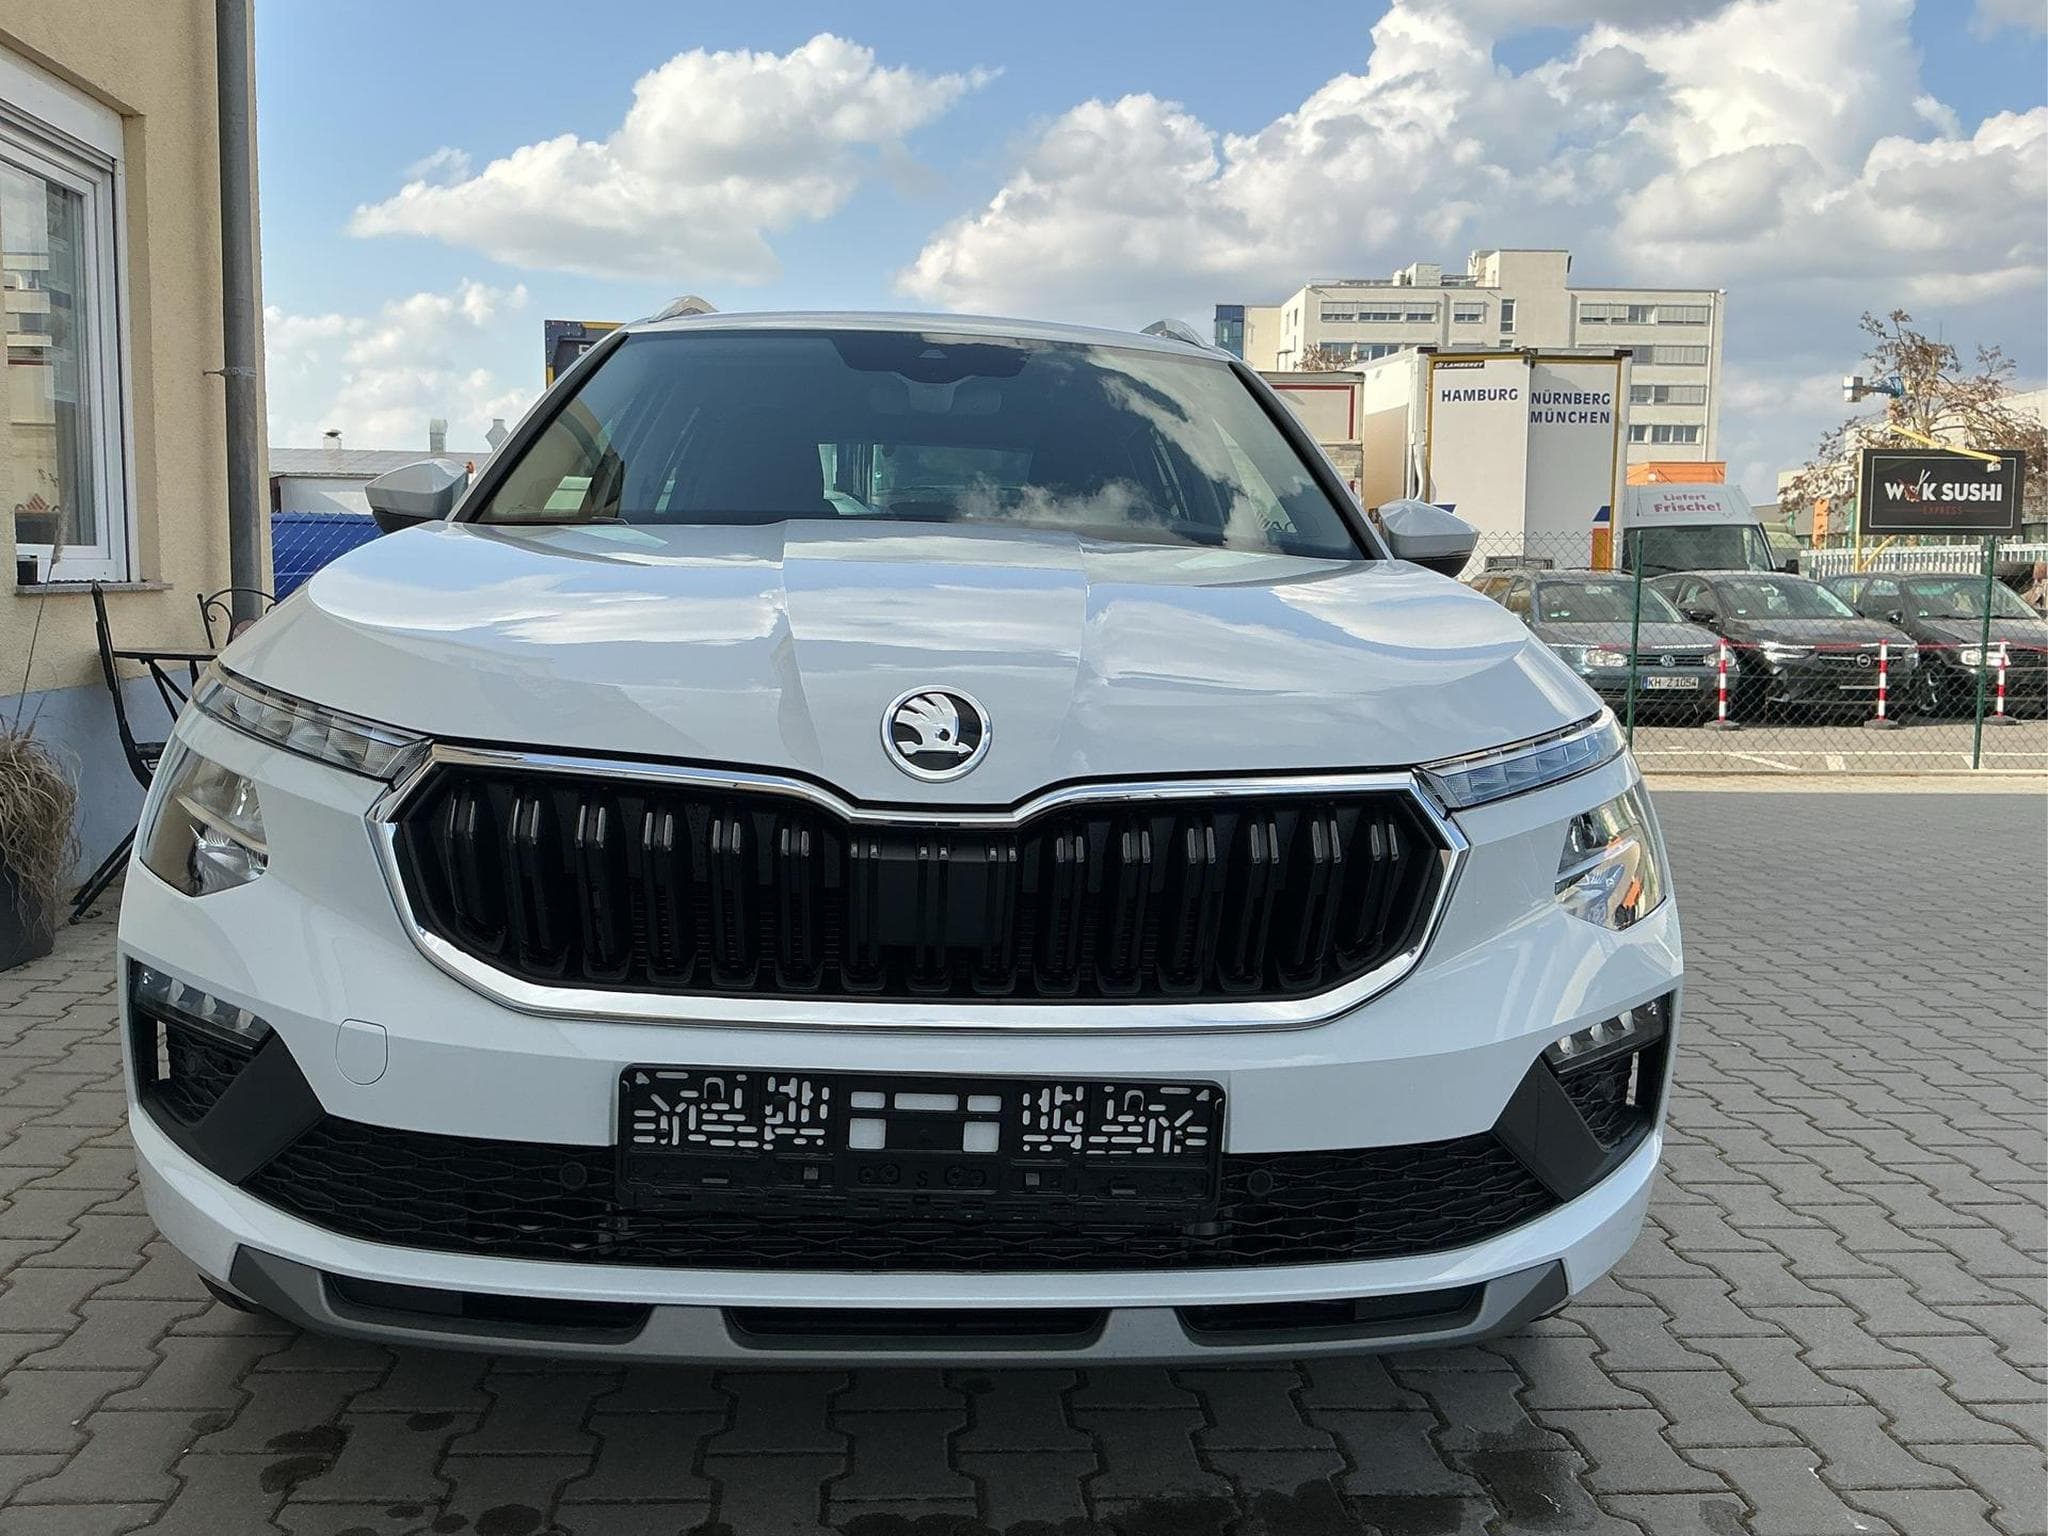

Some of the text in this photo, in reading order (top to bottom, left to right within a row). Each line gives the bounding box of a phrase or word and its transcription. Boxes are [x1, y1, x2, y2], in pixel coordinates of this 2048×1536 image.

[1441, 388, 1519, 402] HAMBURG
[1531, 390, 1611, 405] NÜRNBERG
[1530, 409, 1610, 424] MÜNCHEN
[1663, 493, 1707, 501] Liefert
[1941, 482, 2003, 502] SUSHI
[1653, 502, 1723, 513] Frische!
[1648, 678, 1661, 688] KH
